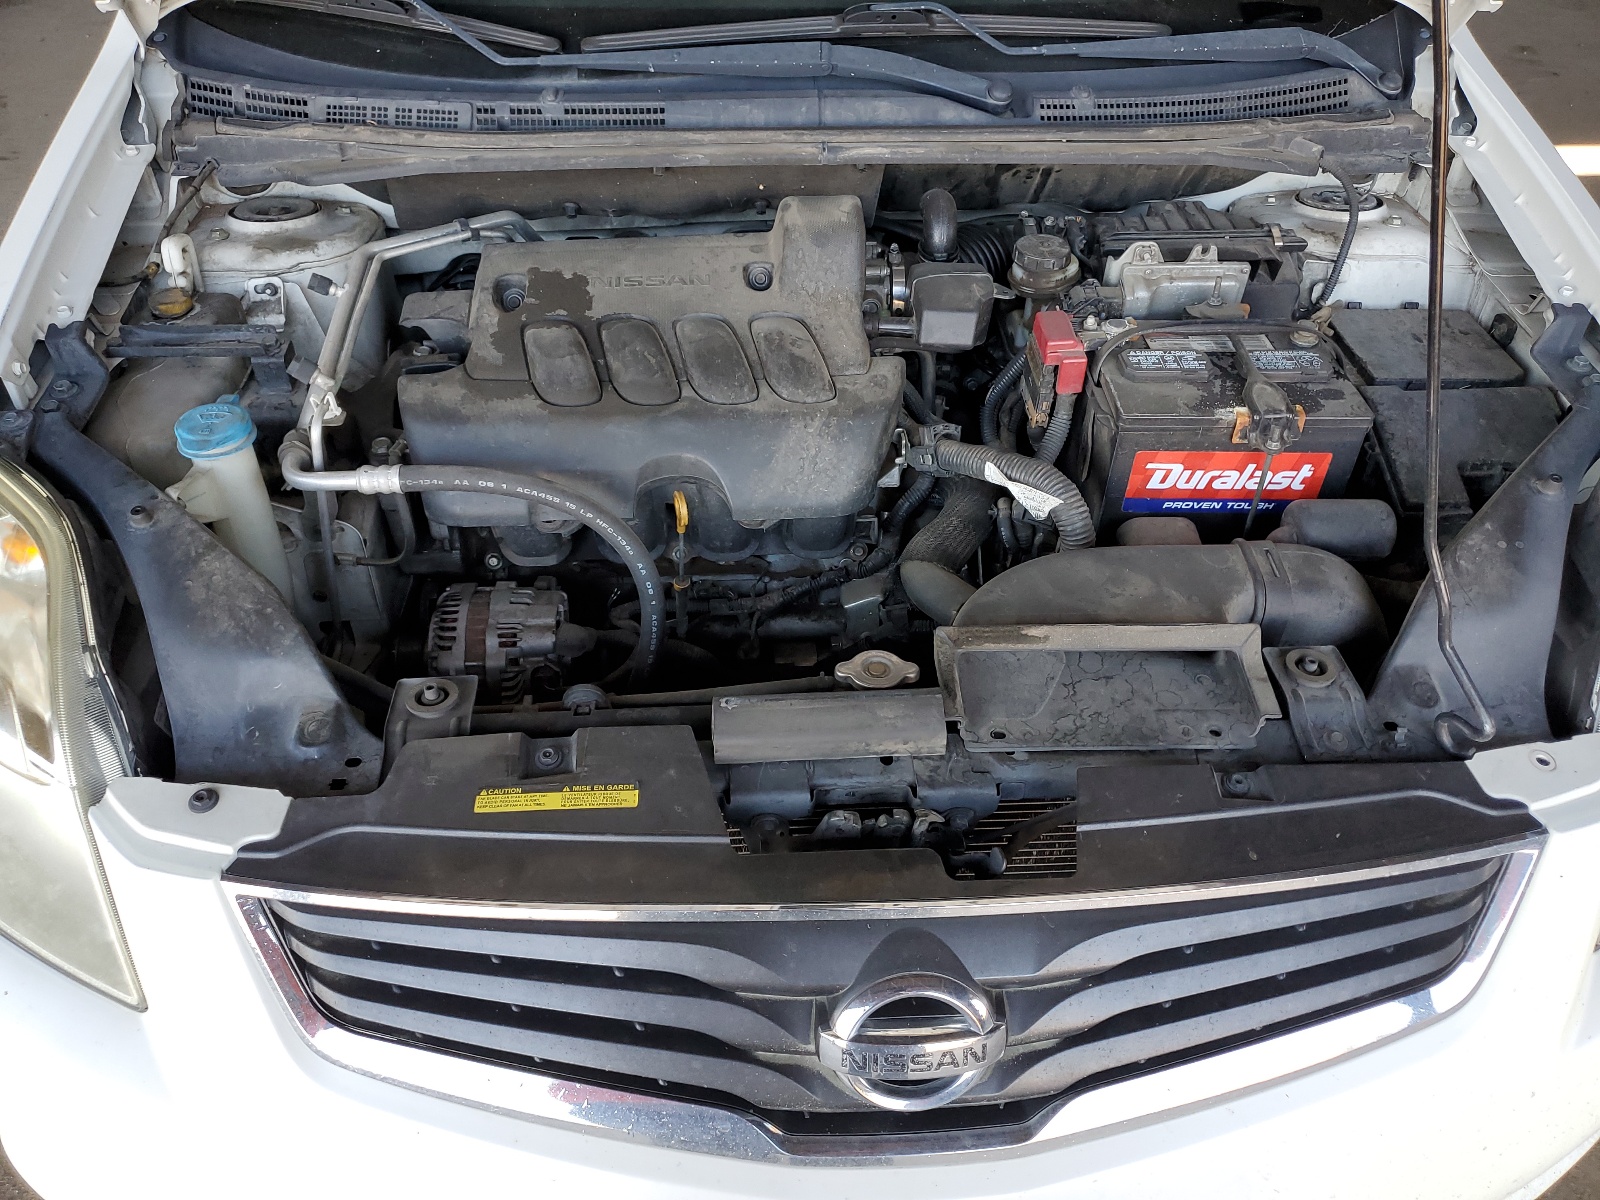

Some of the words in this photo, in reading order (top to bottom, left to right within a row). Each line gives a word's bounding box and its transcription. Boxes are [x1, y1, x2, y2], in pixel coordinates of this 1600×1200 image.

[590, 274, 711, 288] NISSAN
[1145, 463, 1314, 490] Duralast
[1162, 501, 1222, 509] PROVEN
[636, 563, 647, 576] AA
[488, 787, 522, 795] CAUTION
[841, 1043, 988, 1073] NISSAN
